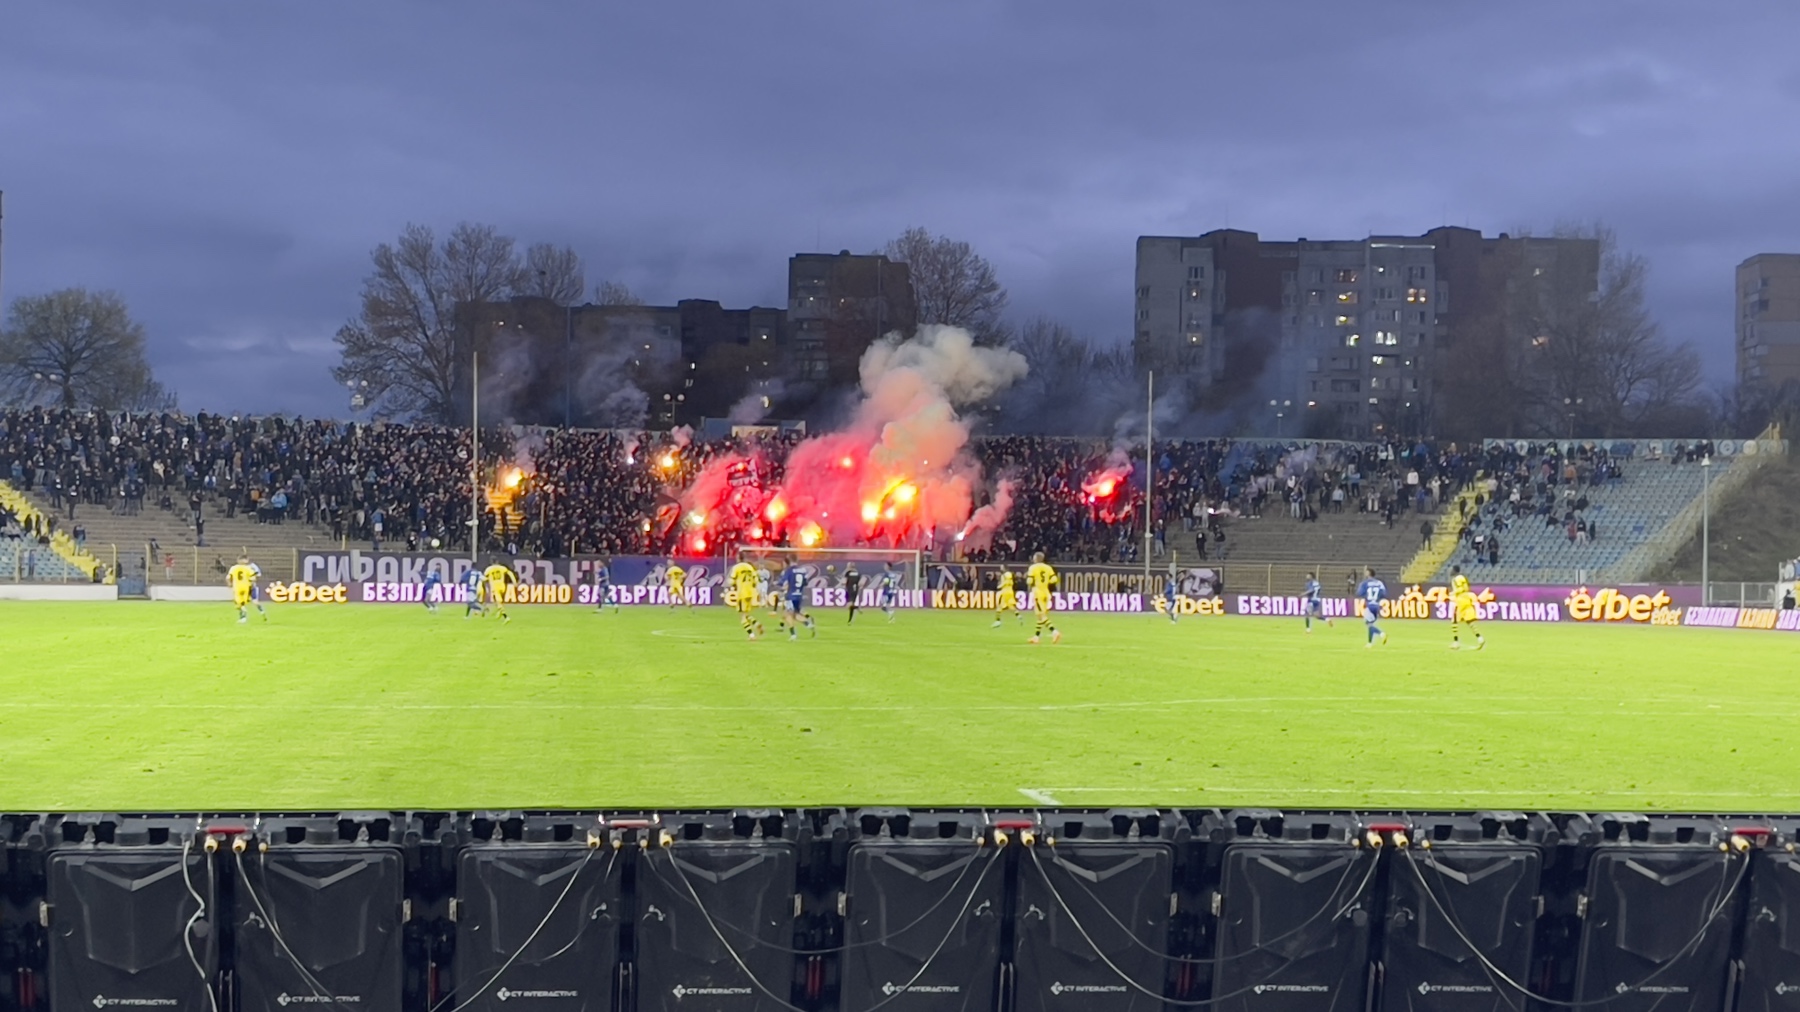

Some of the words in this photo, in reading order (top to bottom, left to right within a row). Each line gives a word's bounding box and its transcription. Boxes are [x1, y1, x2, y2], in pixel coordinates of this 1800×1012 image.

[265, 581, 347, 603] efbet
[363, 582, 469, 602] БЕЗПЛАТН
[489, 584, 572, 604] АЗИНО
[1366, 587, 1380, 601] 17
[1237, 595, 1348, 616] БЕЗПЛАНИ
[1354, 598, 1430, 619] КЗИНО
[1565, 586, 1671, 621] efbet
